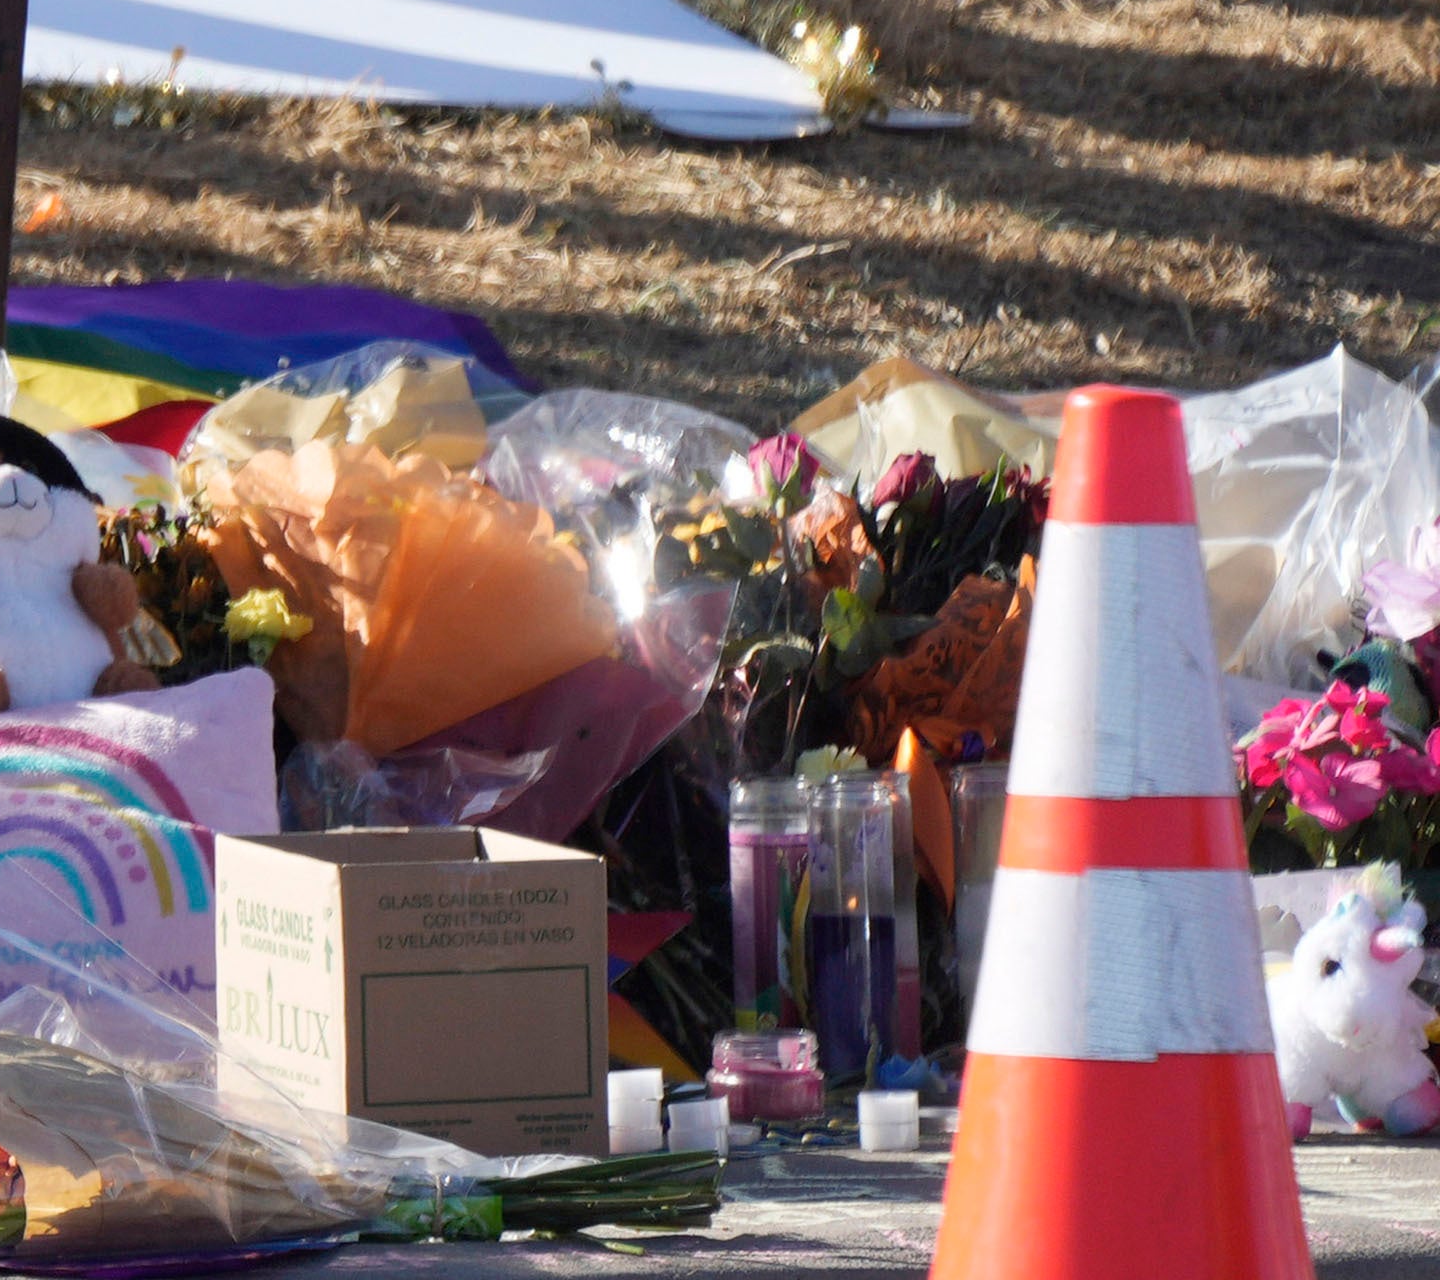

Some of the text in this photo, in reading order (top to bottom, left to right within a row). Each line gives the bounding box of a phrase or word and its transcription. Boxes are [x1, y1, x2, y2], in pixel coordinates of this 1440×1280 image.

[377, 893, 434, 911] GLASS
[438, 890, 505, 908] CANDLE
[236, 897, 314, 945] GLASS CANDLE
[376, 924, 575, 951] 12 VELADORAS EN VASO
